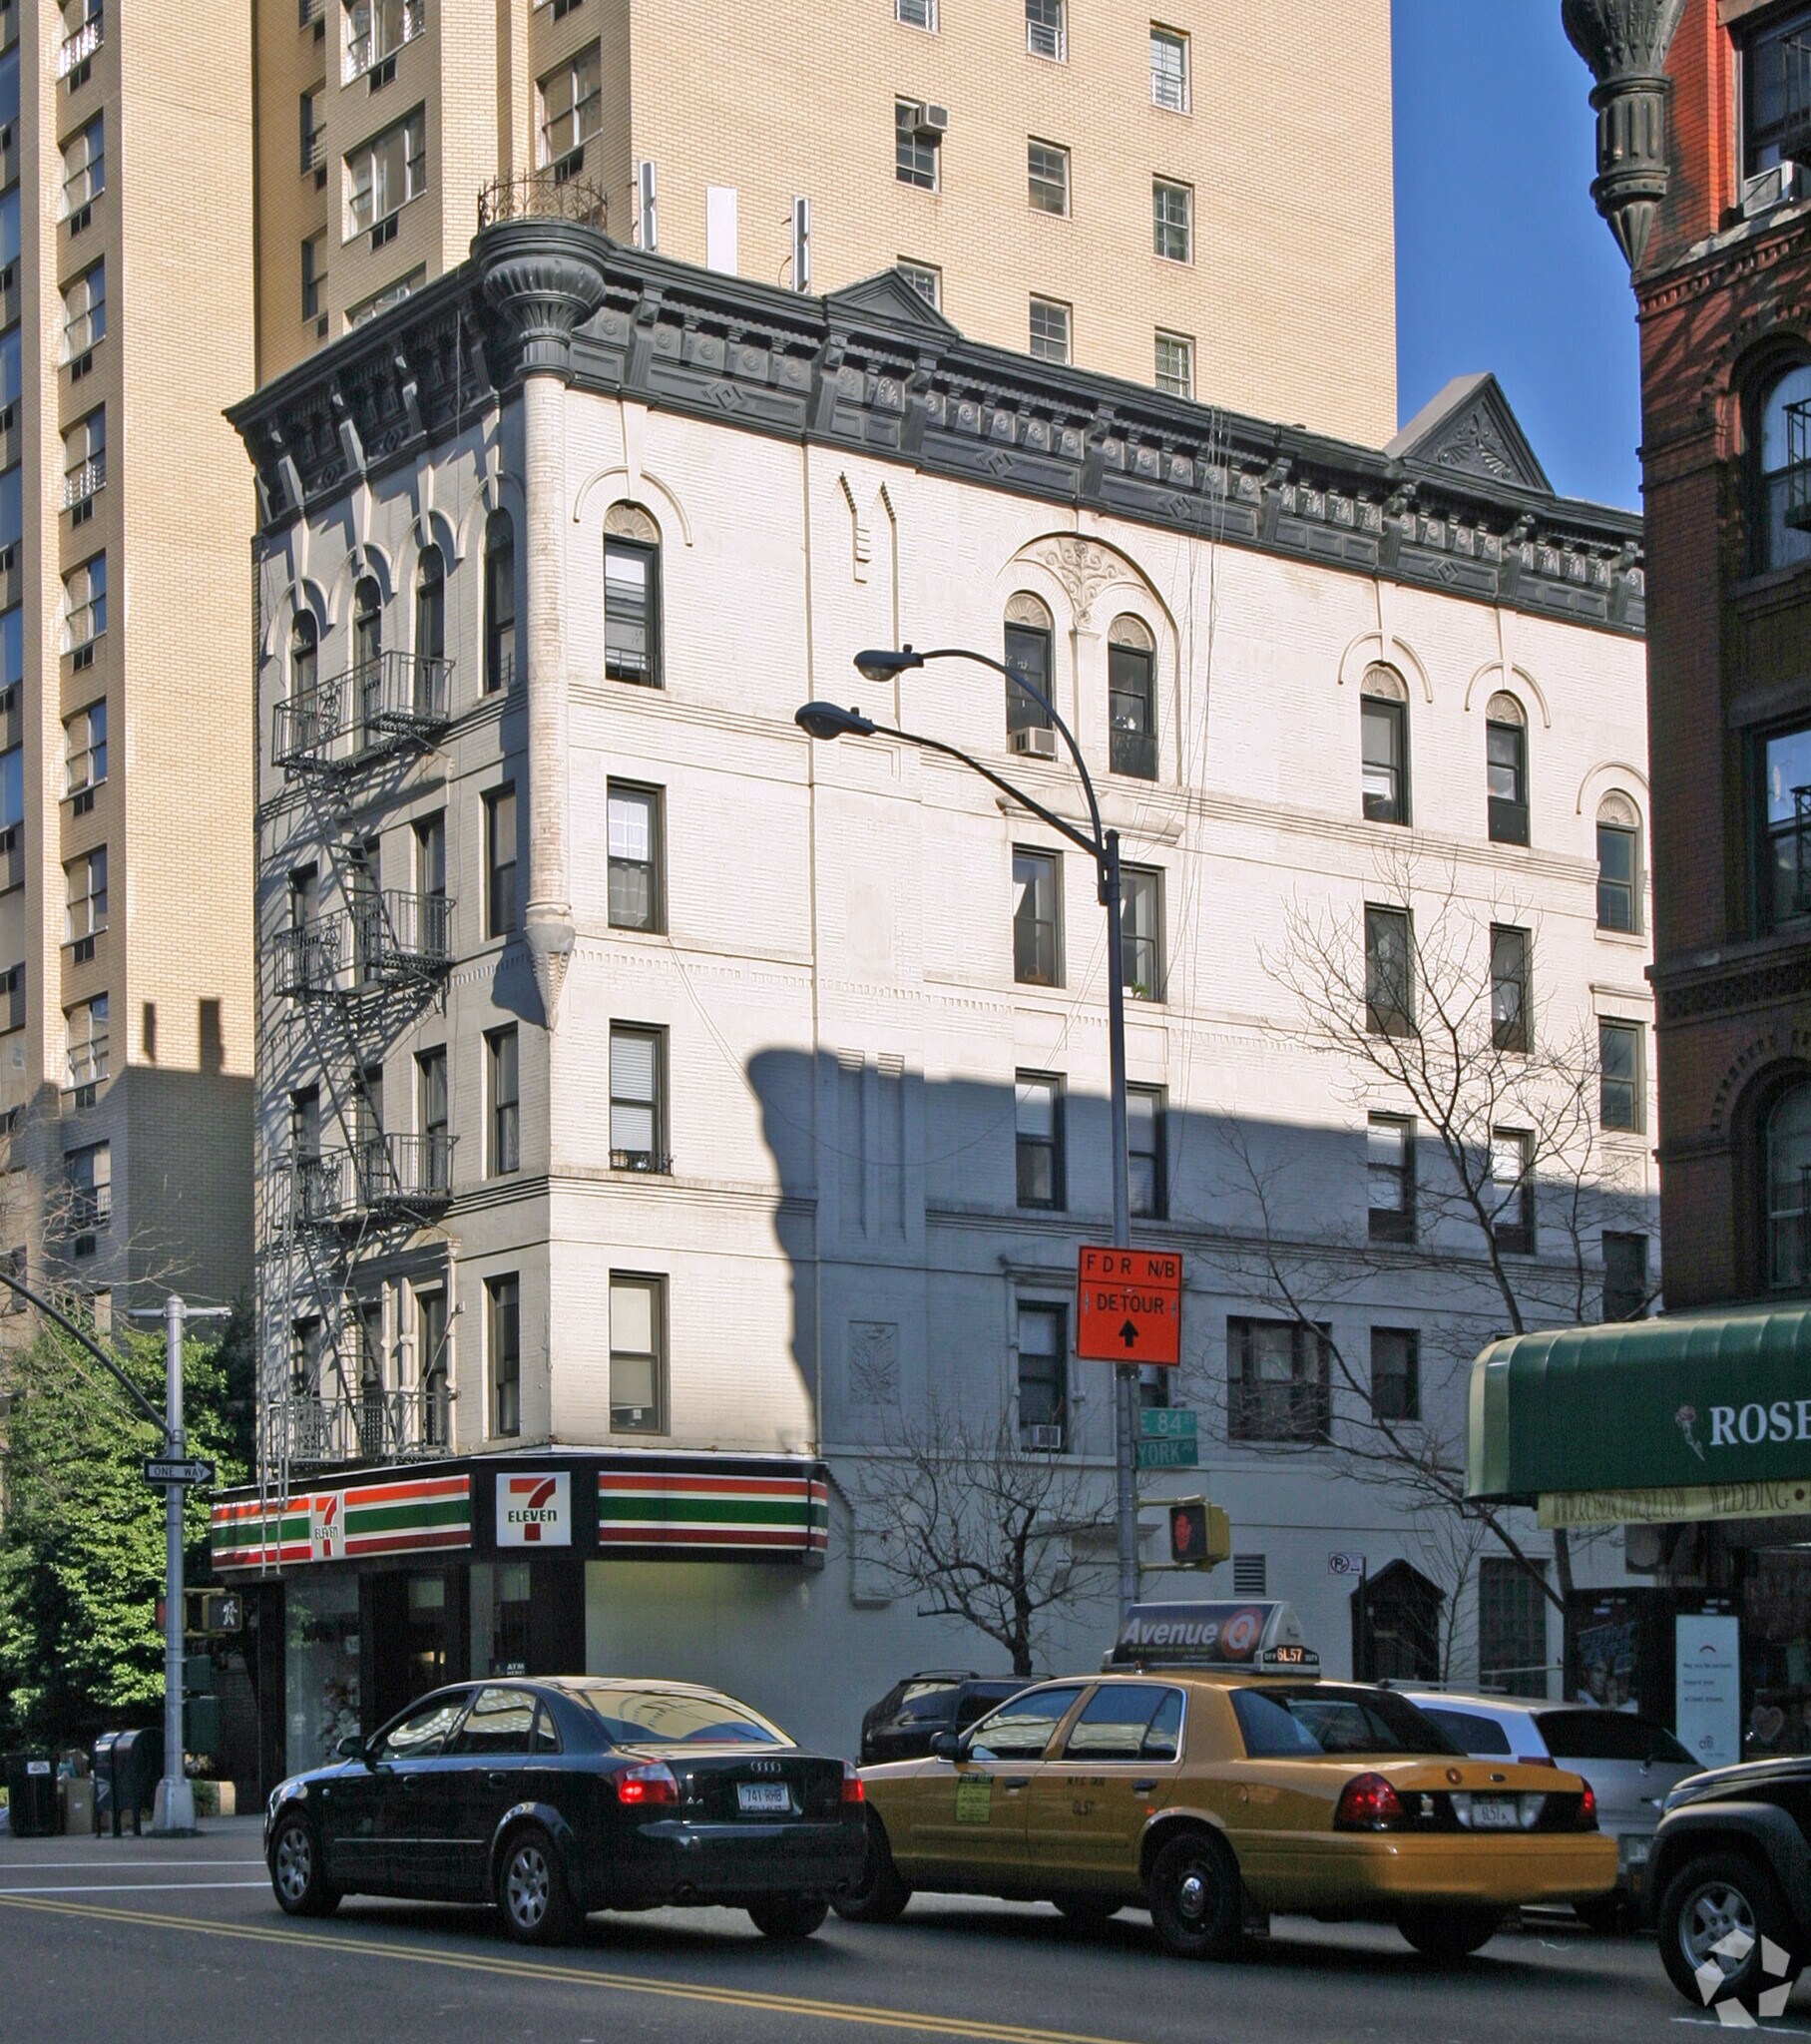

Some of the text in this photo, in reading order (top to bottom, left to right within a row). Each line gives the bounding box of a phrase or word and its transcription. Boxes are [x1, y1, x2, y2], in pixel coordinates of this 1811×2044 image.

[1147, 1260, 1175, 1278] N/B
[1097, 1292, 1163, 1314] DETOUR
[1157, 1411, 1181, 1433] 84
[1138, 1443, 1180, 1465] YORK
[154, 1466, 205, 1477] ONE WAY
[510, 1477, 556, 1541] 7
[1708, 1481, 1790, 1515] WEDDING
[1121, 1614, 1256, 1650] Avenue Q
[1277, 1647, 1303, 1663] 6L57
[745, 1788, 762, 1802] 741
